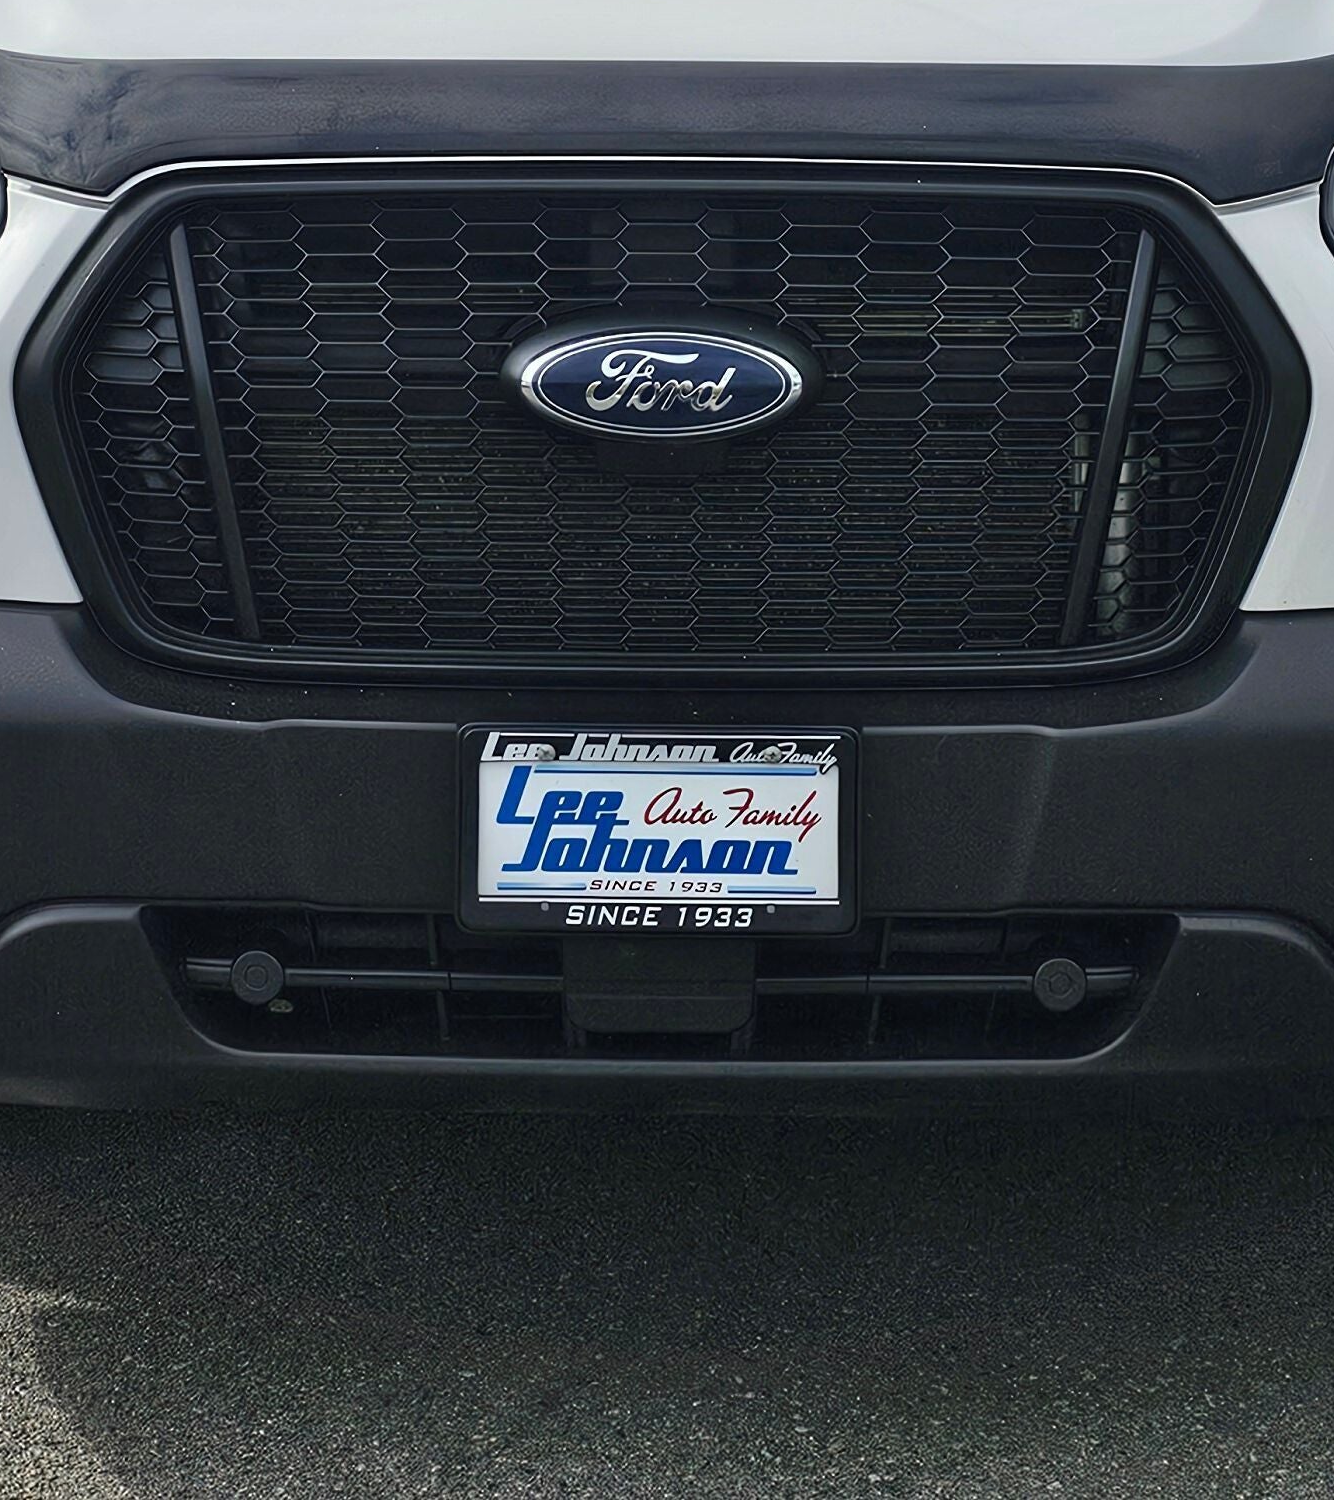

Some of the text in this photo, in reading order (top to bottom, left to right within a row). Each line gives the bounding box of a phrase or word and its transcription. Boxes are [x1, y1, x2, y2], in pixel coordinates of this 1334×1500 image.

[586, 349, 736, 412] Ford
[559, 733, 720, 763] Johnson
[729, 742, 779, 763] Aut
[777, 742, 838, 773] Family
[496, 765, 630, 826] Lee
[643, 787, 822, 843] Auto Family
[501, 818, 799, 875] Johnson
[589, 879, 723, 893] SINCE 1933
[565, 905, 753, 928] SINCE 1933
